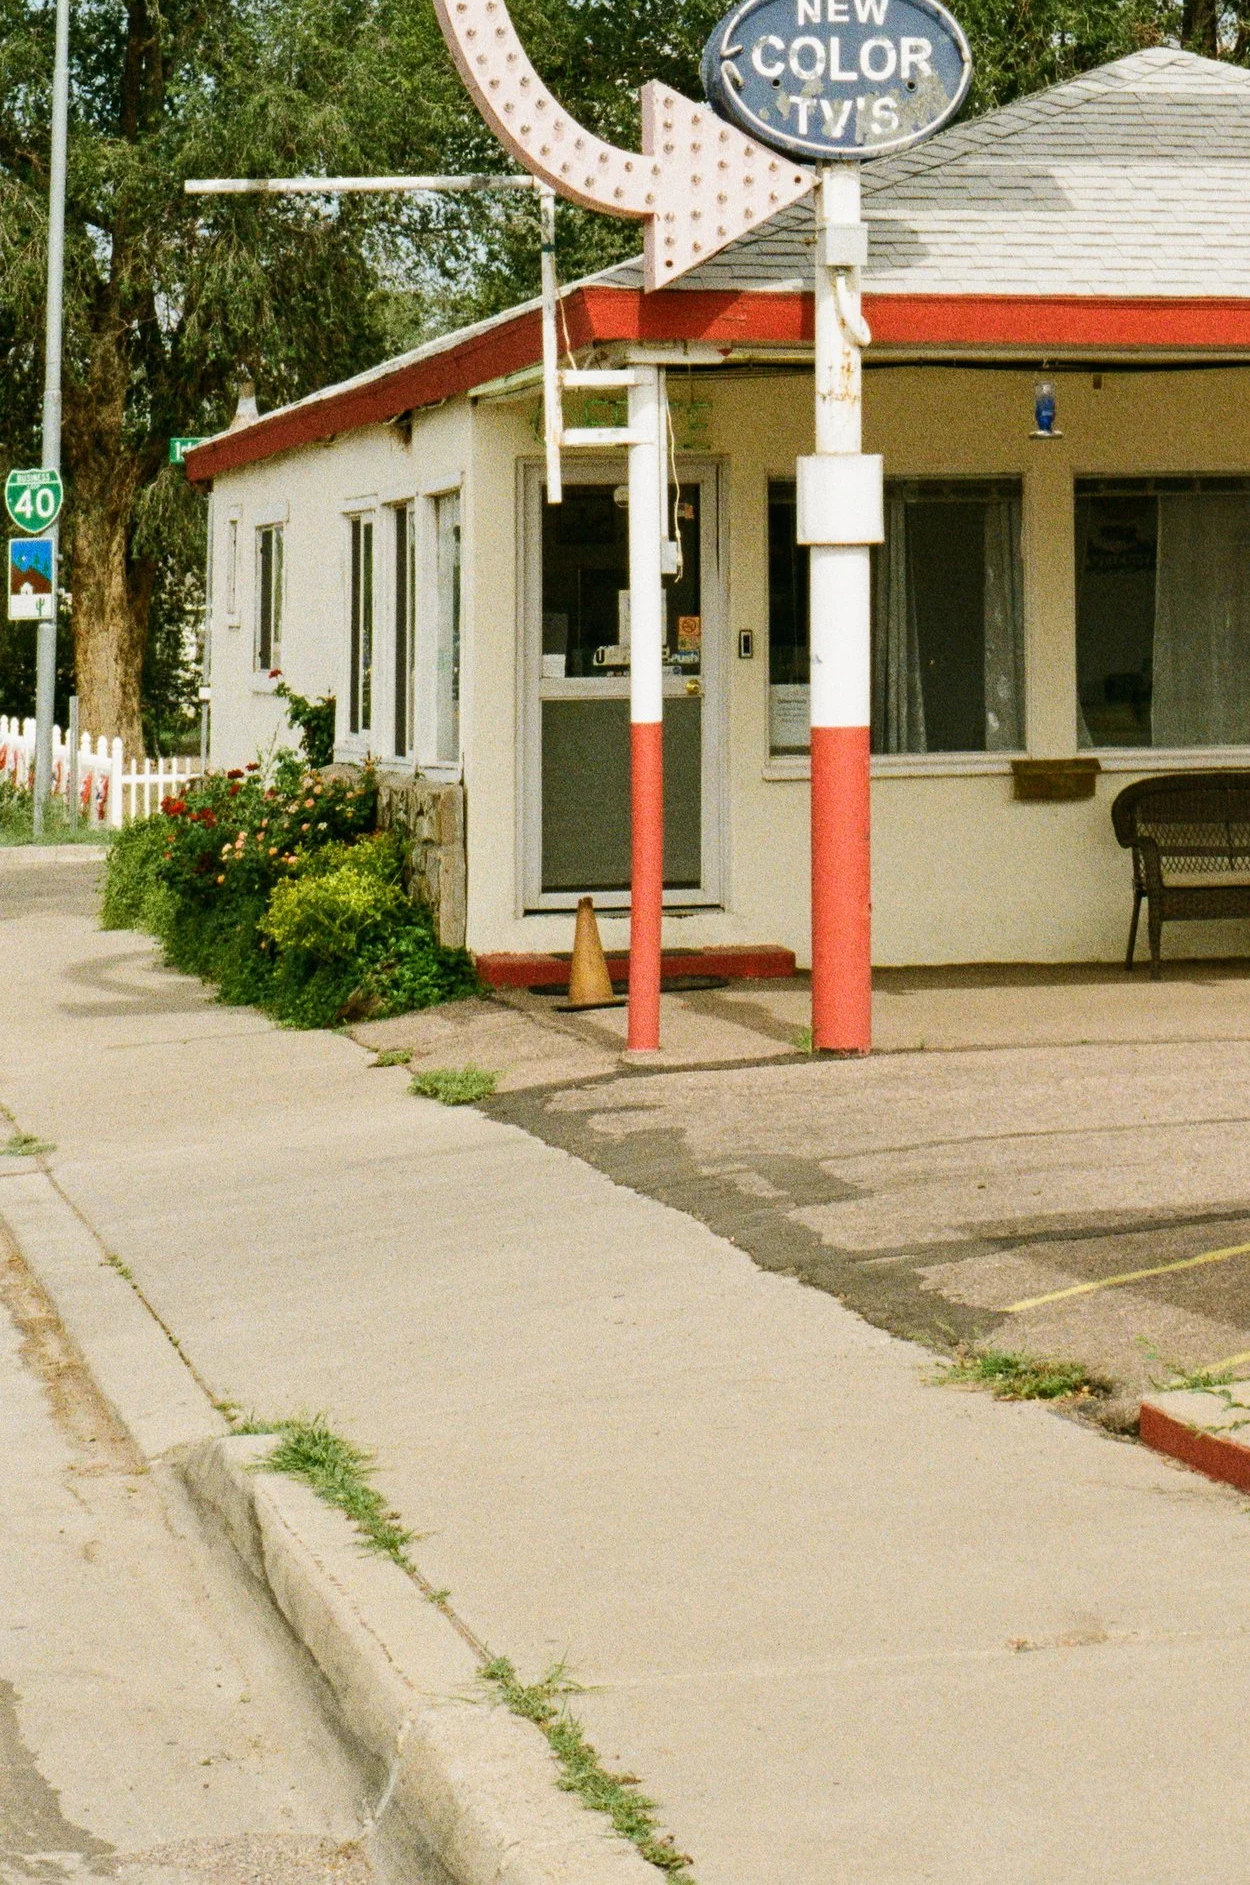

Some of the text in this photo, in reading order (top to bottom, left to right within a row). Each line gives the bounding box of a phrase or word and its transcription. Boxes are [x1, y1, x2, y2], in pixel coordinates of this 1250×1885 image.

[751, 35, 932, 81] COLOR
[788, 95, 899, 139] TV'S
[14, 488, 54, 519] 40
